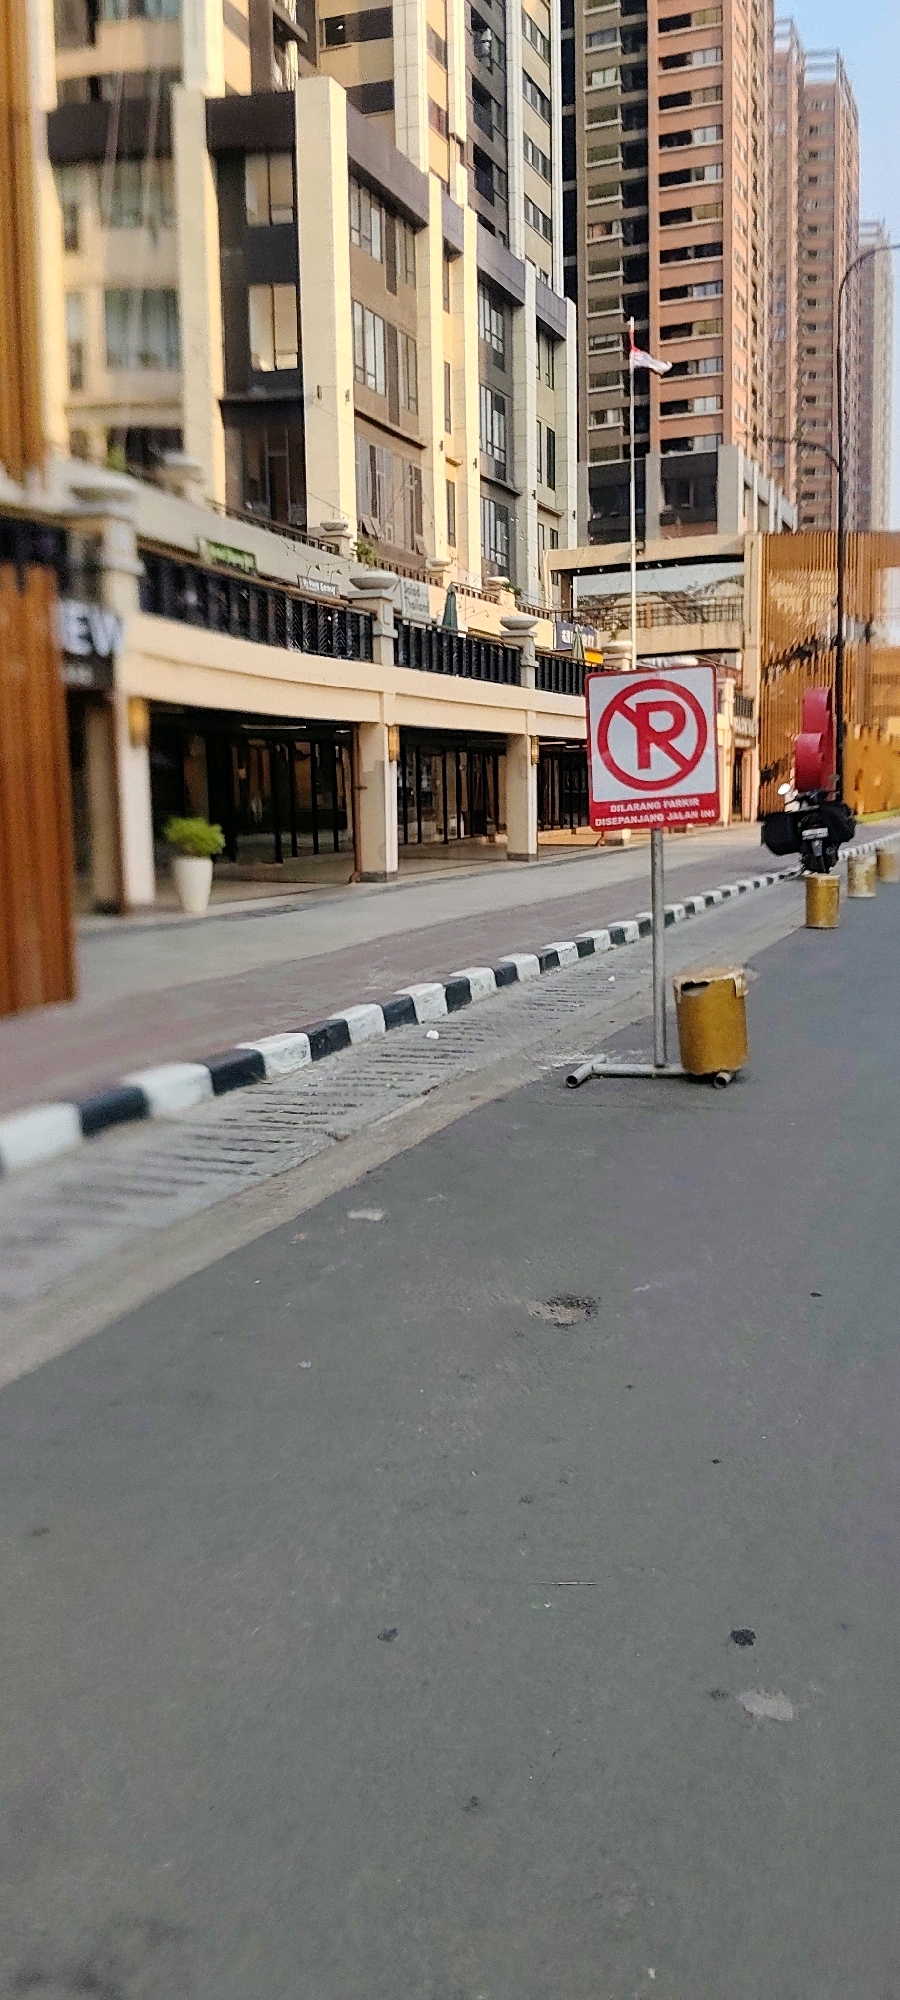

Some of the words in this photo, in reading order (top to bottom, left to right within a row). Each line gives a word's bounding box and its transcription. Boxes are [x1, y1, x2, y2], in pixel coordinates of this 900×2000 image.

[610, 801, 661, 813] DILARANG
[663, 798, 700, 809] PARKIR
[595, 813, 665, 827] DISEPANJANG
[667, 810, 699, 821] JALAN
[701, 809, 715, 818] INI
